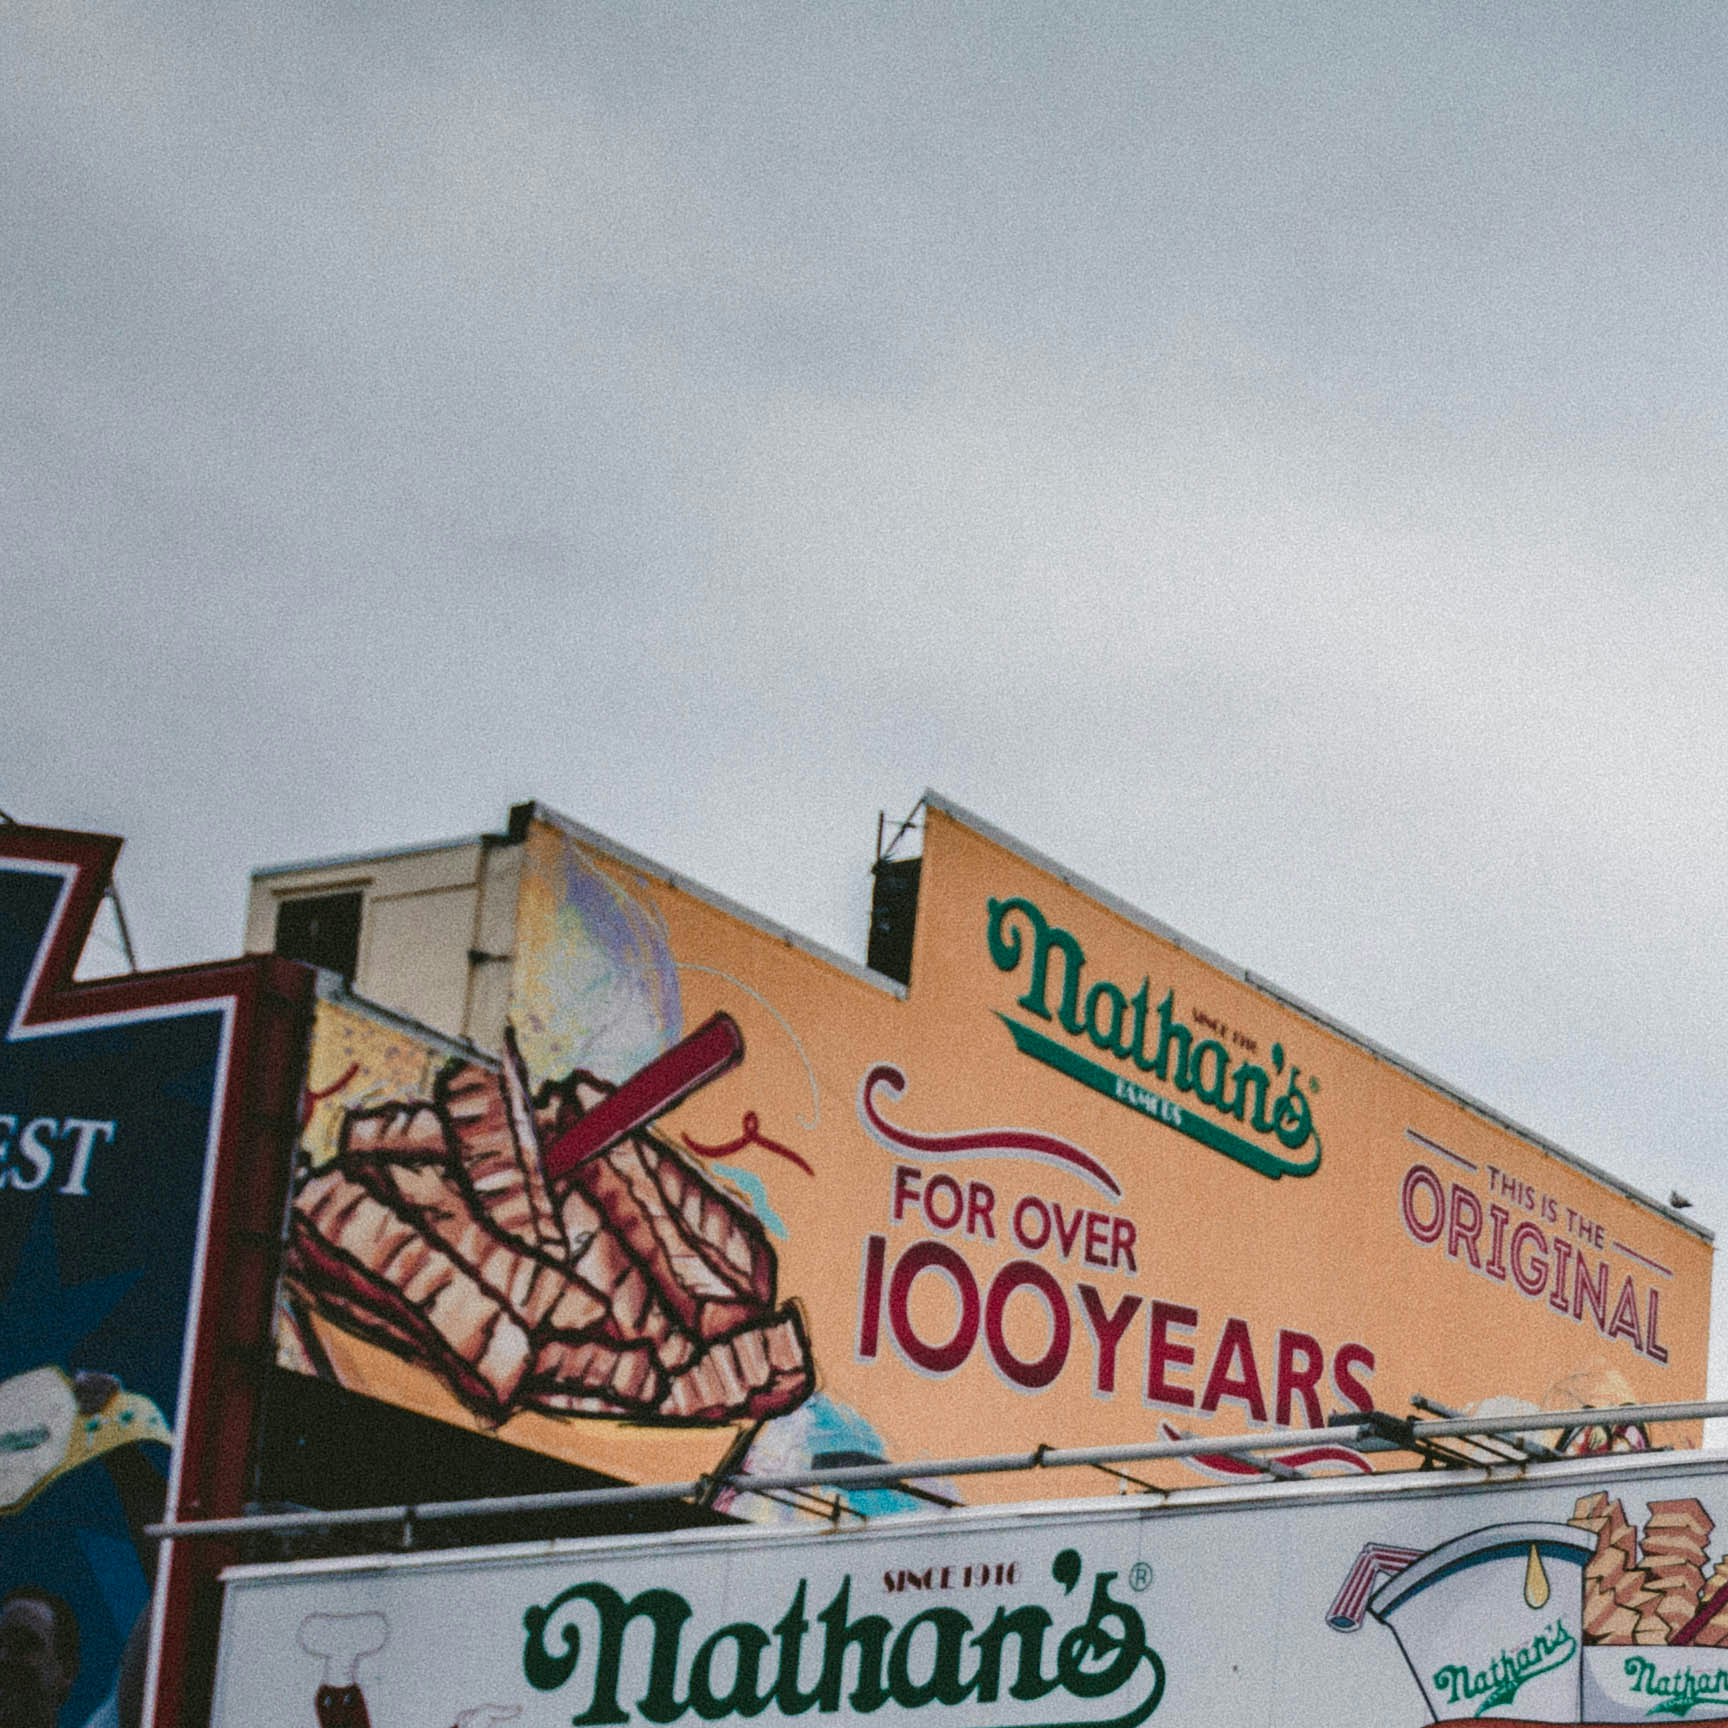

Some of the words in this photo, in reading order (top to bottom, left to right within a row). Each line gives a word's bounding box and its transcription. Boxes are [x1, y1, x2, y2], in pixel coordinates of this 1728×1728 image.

[985, 896, 1314, 1150] Nathan's
[893, 1165, 997, 1240] FOR
[1011, 1194, 1140, 1274] OVER
[1400, 1162, 1671, 1365] ORIGINAL
[1484, 1163, 1538, 1213] THIS
[1541, 1190, 1560, 1227] IS
[1564, 1200, 1608, 1252] THE
[856, 1232, 1073, 1392] 100
[522, 1547, 1148, 1727] Nathan's
[882, 1565, 957, 1594] SINCE
